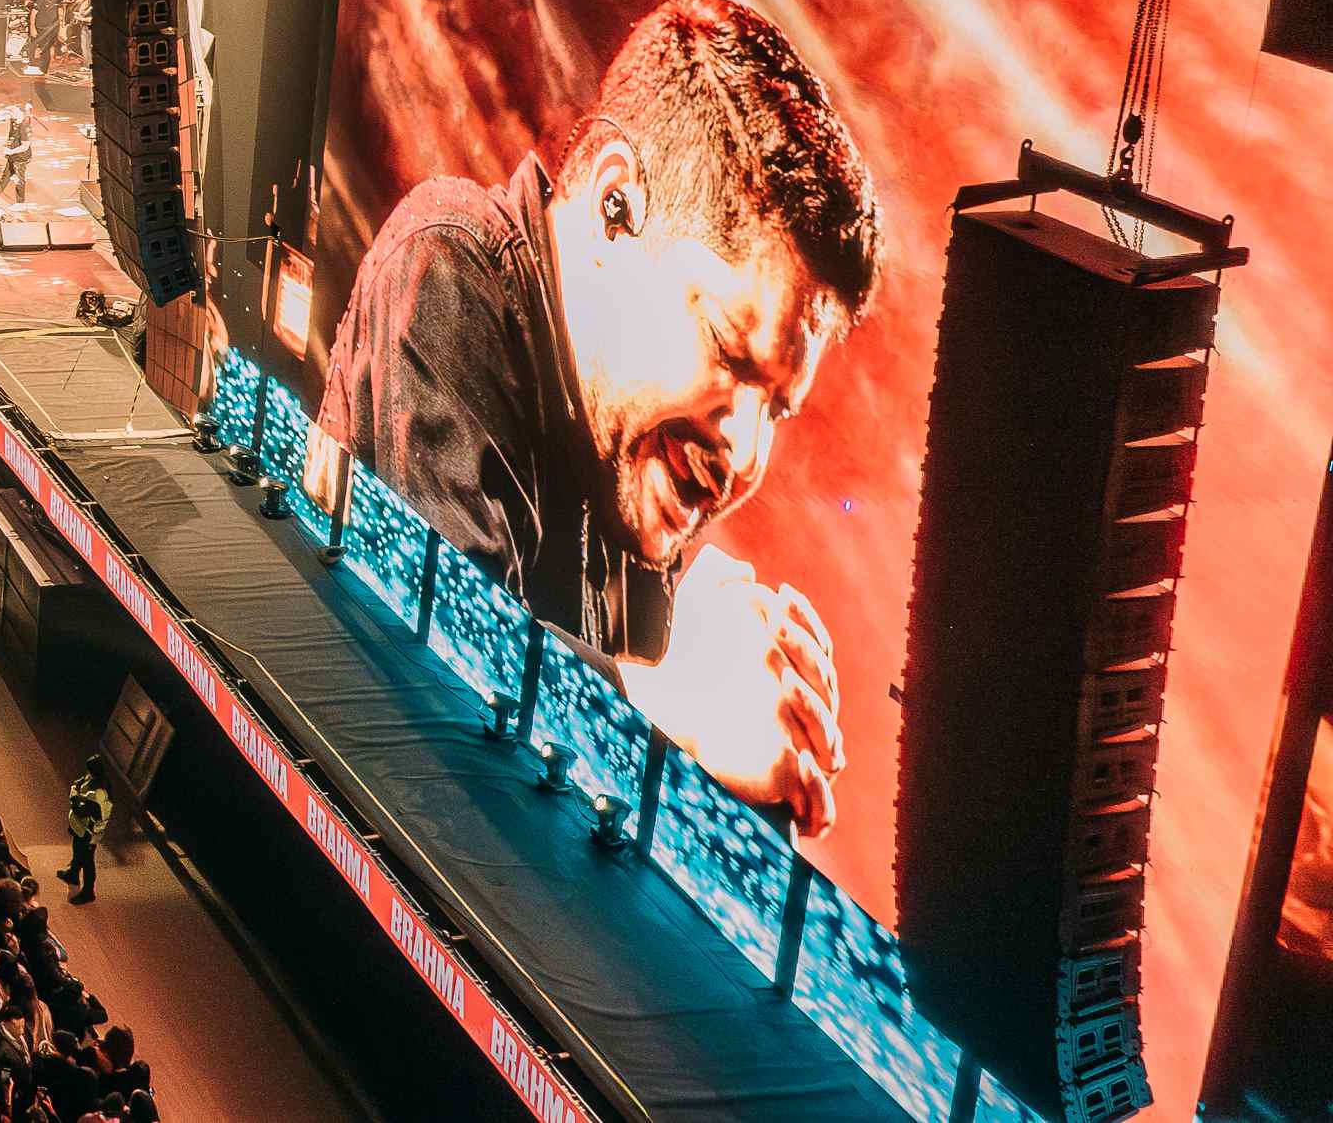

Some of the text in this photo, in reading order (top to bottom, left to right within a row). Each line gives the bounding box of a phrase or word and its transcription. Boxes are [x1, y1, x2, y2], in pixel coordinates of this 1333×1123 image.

[4, 432, 40, 497] BRAHMA
[50, 487, 93, 560] BRAHMA
[106, 552, 154, 632] BRAHMA
[167, 622, 217, 713] BRAHMA
[231, 705, 289, 802] BRAHMA
[307, 795, 372, 902] BRAHMA
[391, 896, 466, 1021] BRAHMA
[491, 1016, 576, 1123] BRAHM
